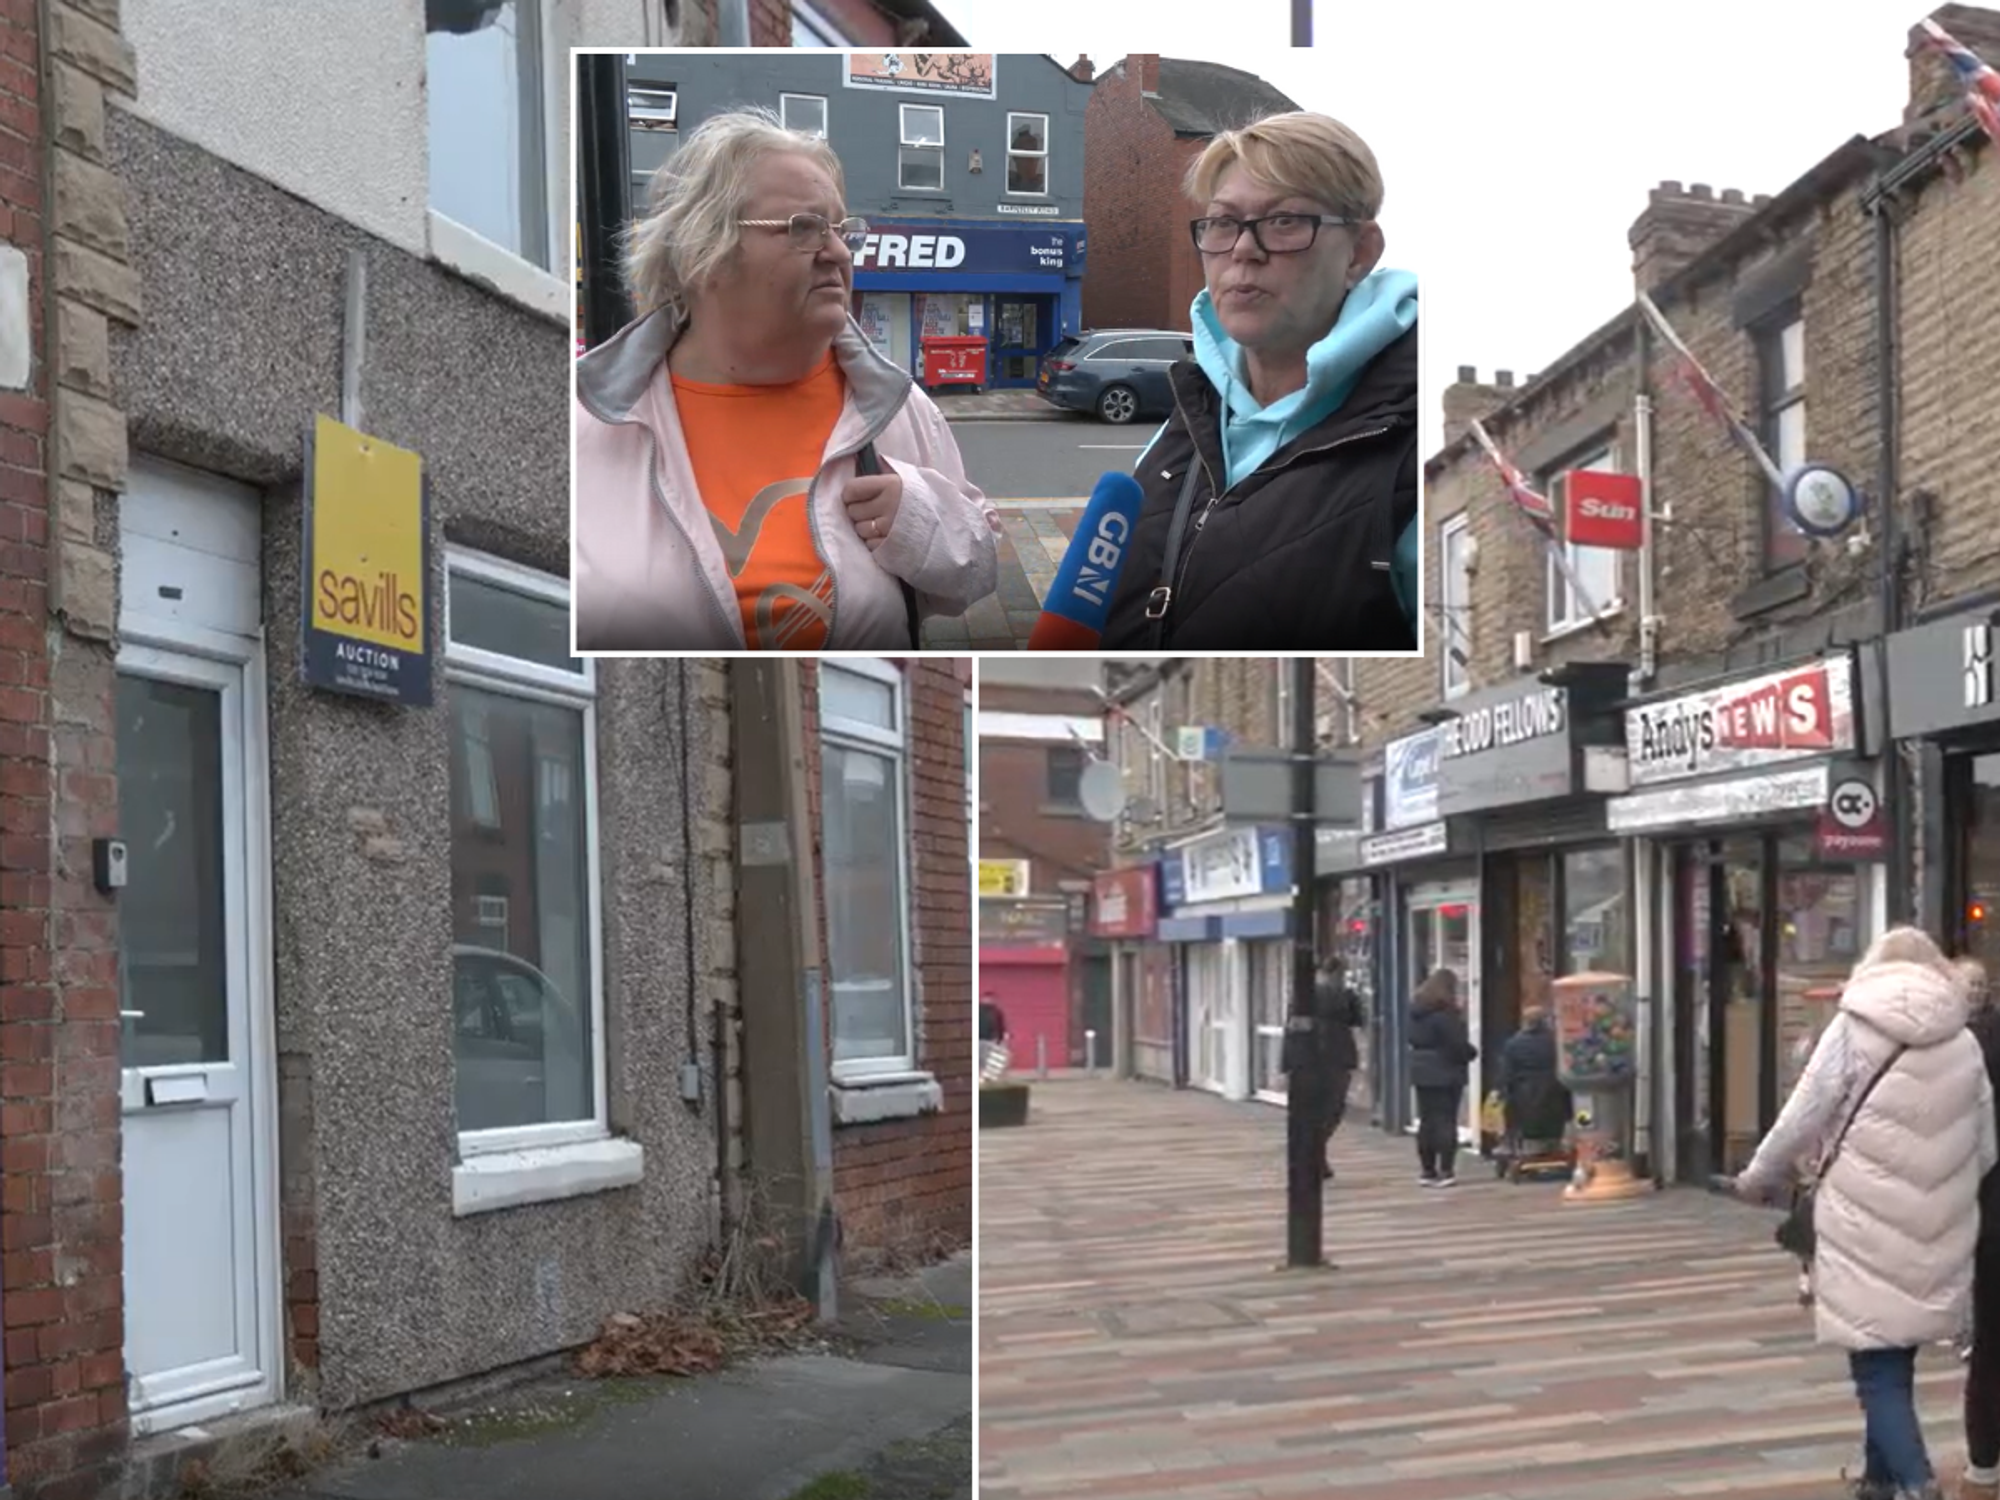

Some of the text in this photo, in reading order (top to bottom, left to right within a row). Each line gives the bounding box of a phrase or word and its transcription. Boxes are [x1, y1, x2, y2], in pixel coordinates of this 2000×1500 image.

[853, 234, 966, 267] FRED
[1030, 245, 1063, 255] bonus
[1040, 256, 1063, 268] king
[1579, 497, 1637, 521] Sun
[318, 570, 417, 639] savills
[335, 643, 400, 670] AUCTION
[1717, 684, 1818, 739] NEWS
